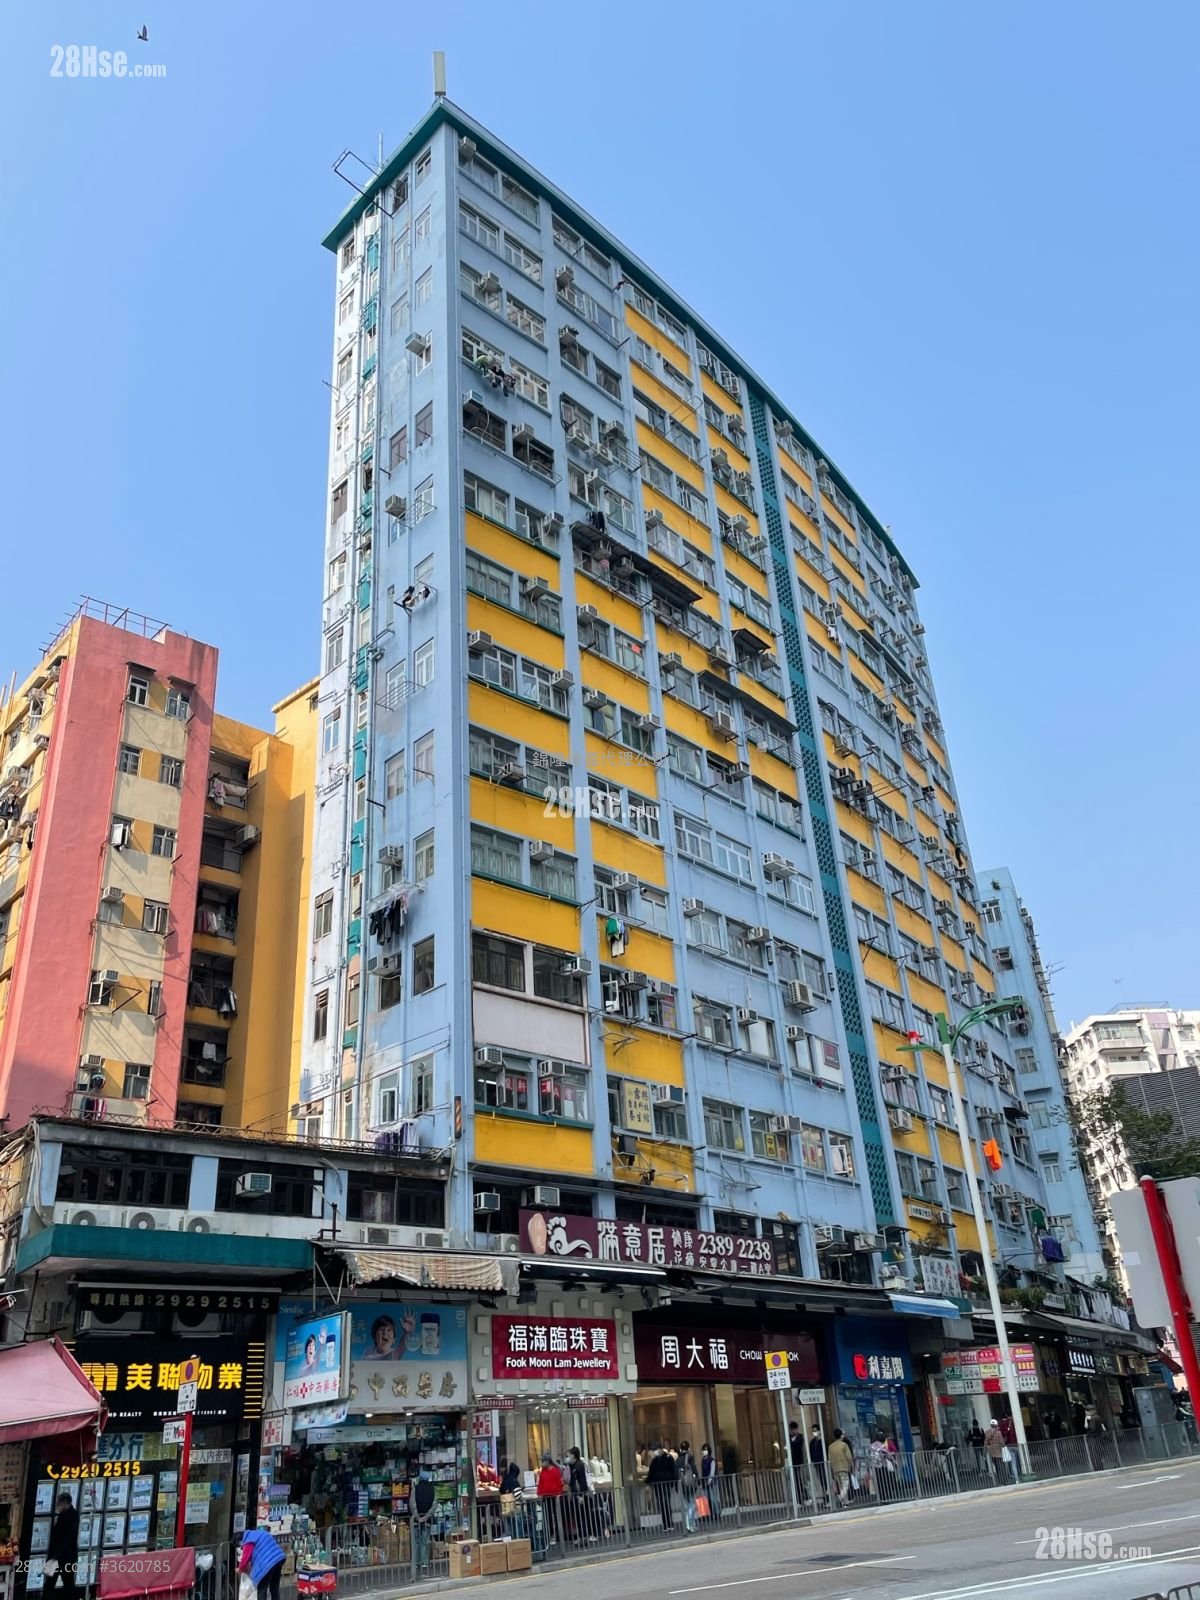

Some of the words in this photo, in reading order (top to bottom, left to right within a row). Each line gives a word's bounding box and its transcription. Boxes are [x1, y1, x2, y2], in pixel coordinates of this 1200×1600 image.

[597, 1220, 666, 1264] 滿意居
[698, 1233, 734, 1257] 2389
[737, 1238, 772, 1261] 2238
[155, 1294, 210, 1308] 2929
[218, 1296, 270, 1309] 2515
[508, 1324, 609, 1353] 福滿臨珠寶
[506, 1356, 527, 1368] Fook
[529, 1357, 552, 1368] Moon
[554, 1358, 572, 1369] Lam
[573, 1357, 611, 1370] Jewellery
[661, 1335, 729, 1370] 周大福
[740, 1350, 763, 1361] CHOW
[103, 1461, 141, 1477] 2515
